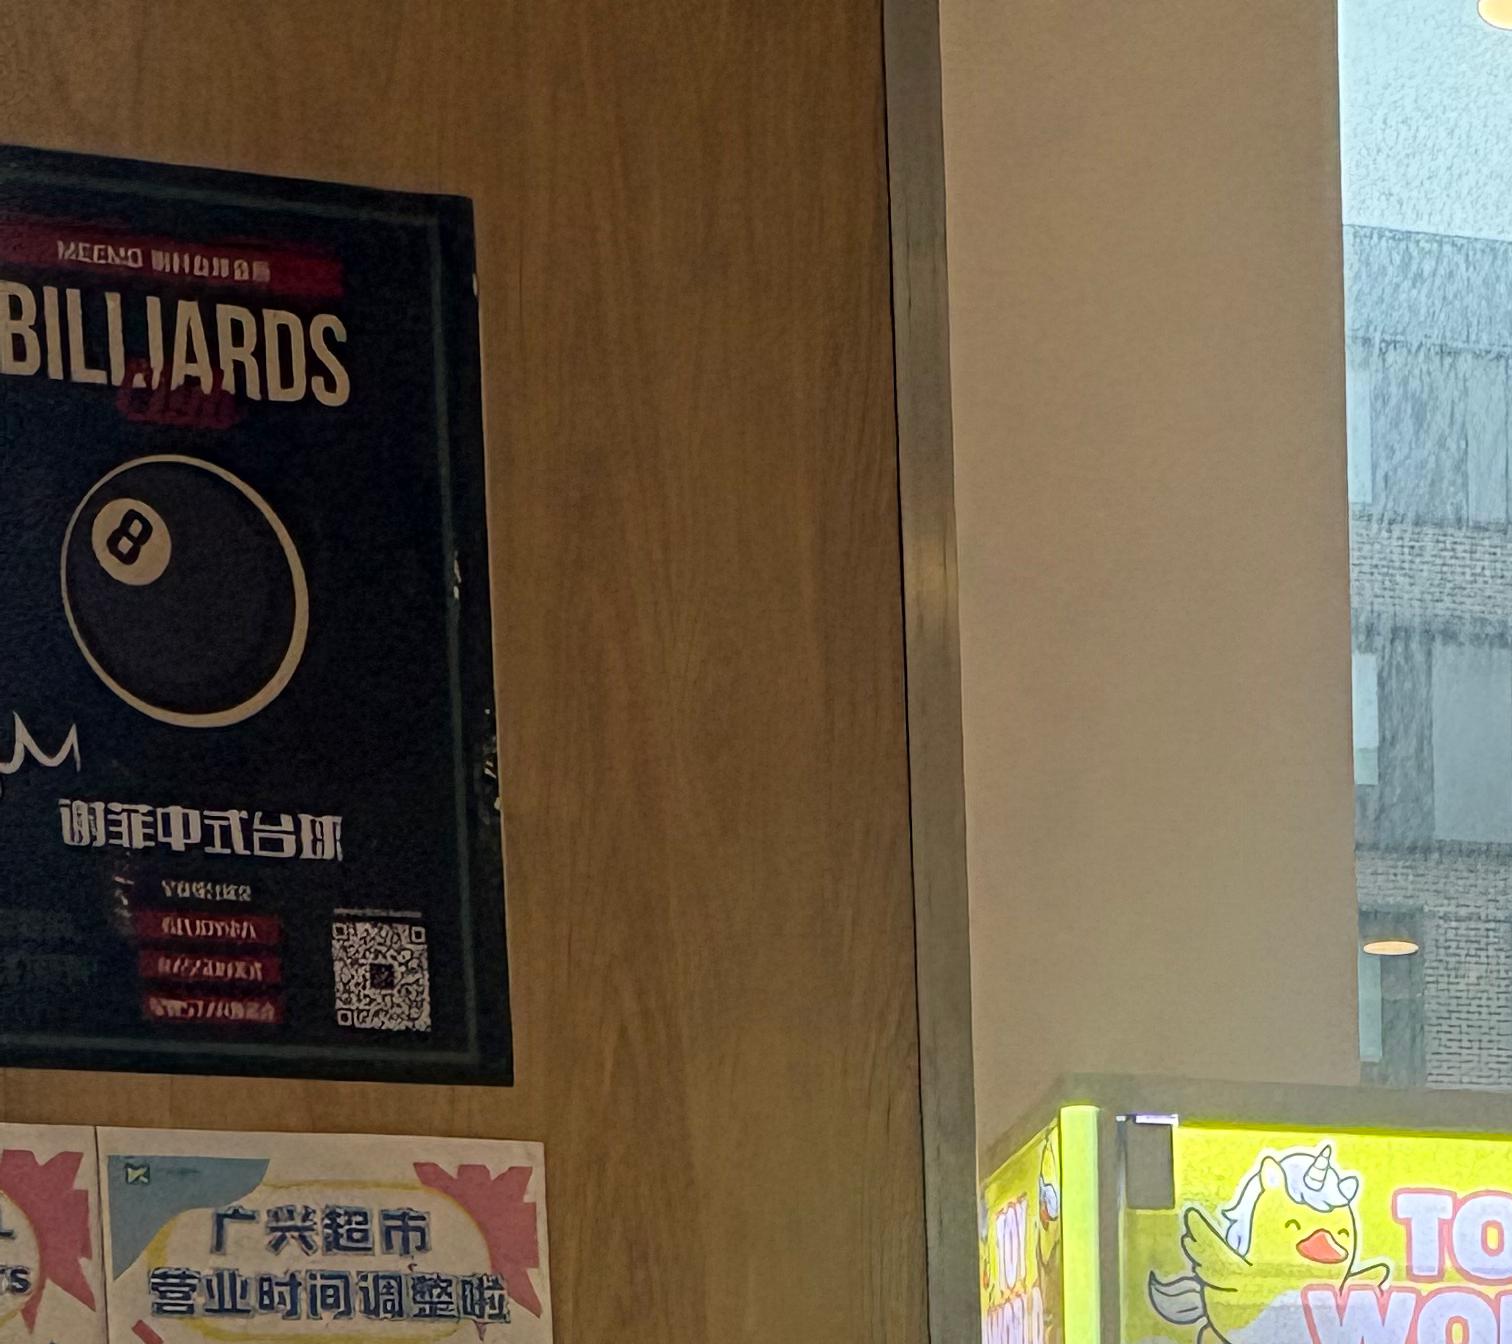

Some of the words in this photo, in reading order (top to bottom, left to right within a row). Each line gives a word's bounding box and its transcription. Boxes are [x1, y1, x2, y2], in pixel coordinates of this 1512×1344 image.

[0, 279, 350, 407] BILLIARDS
[106, 508, 153, 565] 8
[210, 1206, 432, 1256] 广兴超市
[148, 1266, 511, 1323] 营业时间调整啦
